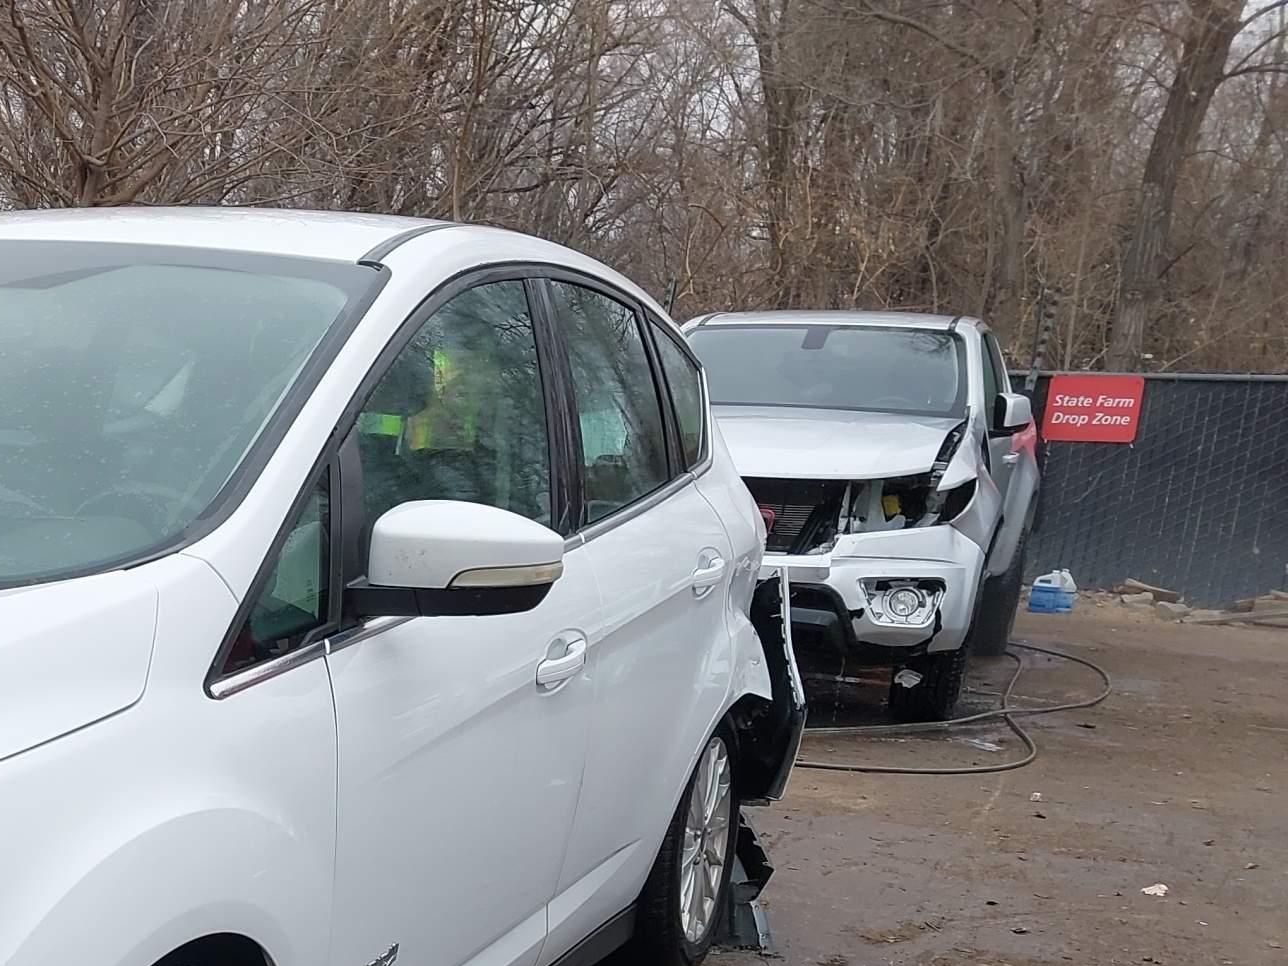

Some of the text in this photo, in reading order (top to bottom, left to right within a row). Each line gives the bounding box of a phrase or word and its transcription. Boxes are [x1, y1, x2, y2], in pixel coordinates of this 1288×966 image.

[1053, 394, 1134, 408] State Farm
[1051, 412, 1130, 427] Drop Zone
